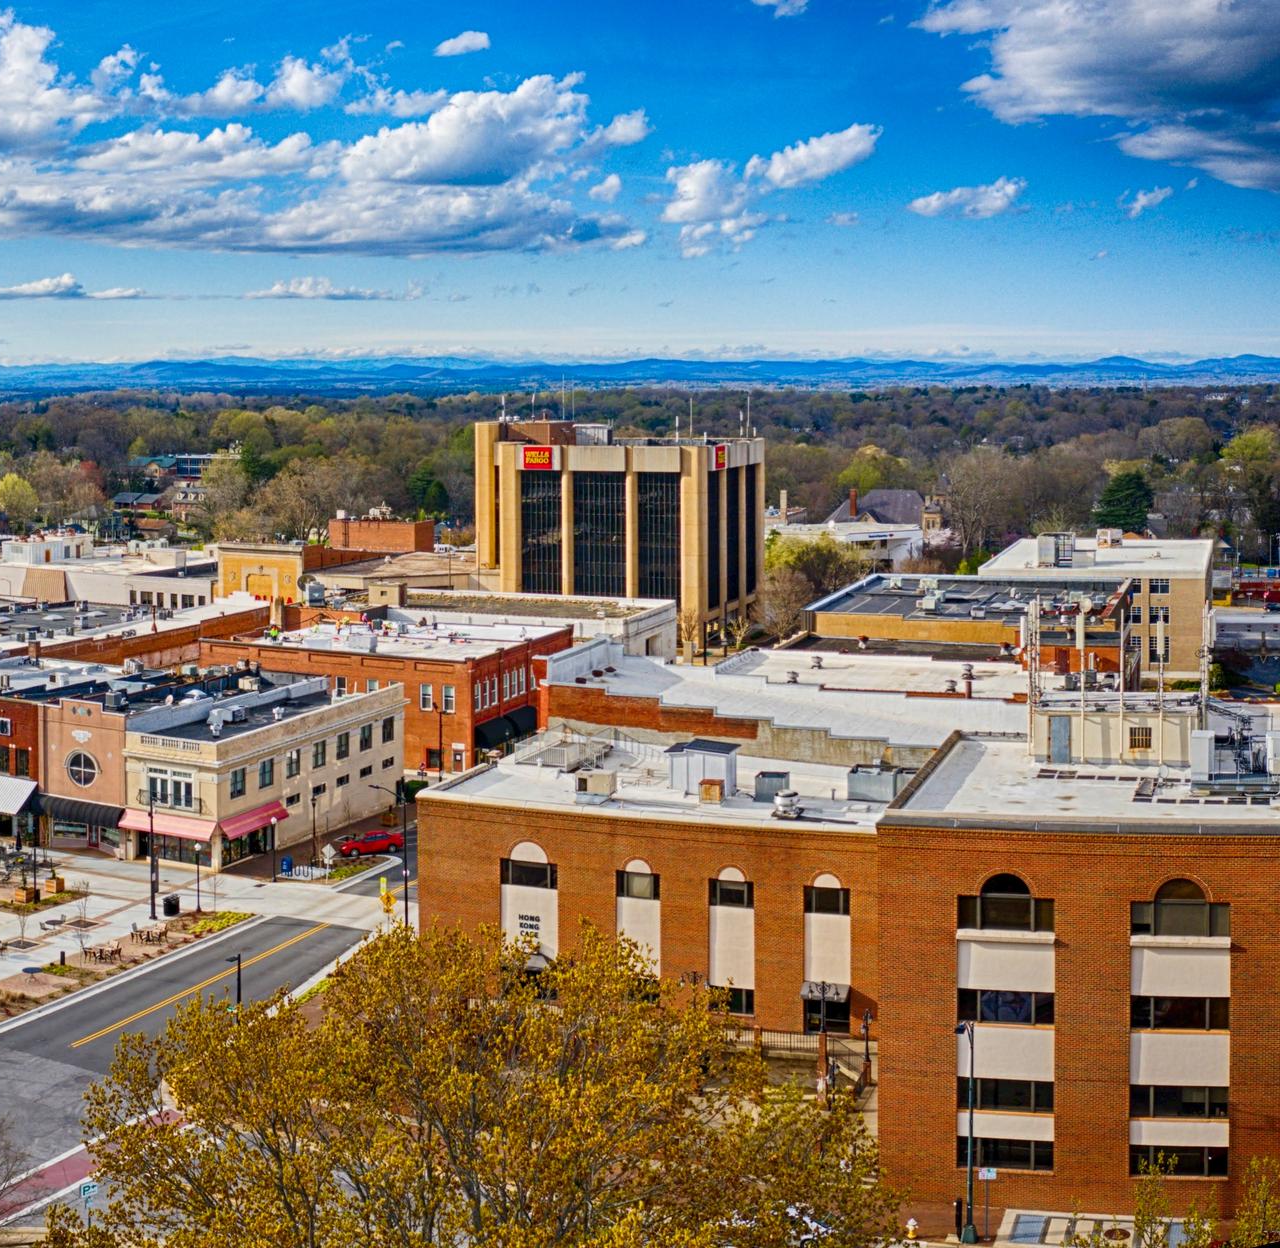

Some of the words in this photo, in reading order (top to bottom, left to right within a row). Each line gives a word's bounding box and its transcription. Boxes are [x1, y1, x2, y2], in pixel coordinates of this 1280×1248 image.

[519, 914, 540, 922] HONG
[520, 922, 540, 930] KONG
[83, 1185, 91, 1196] P
